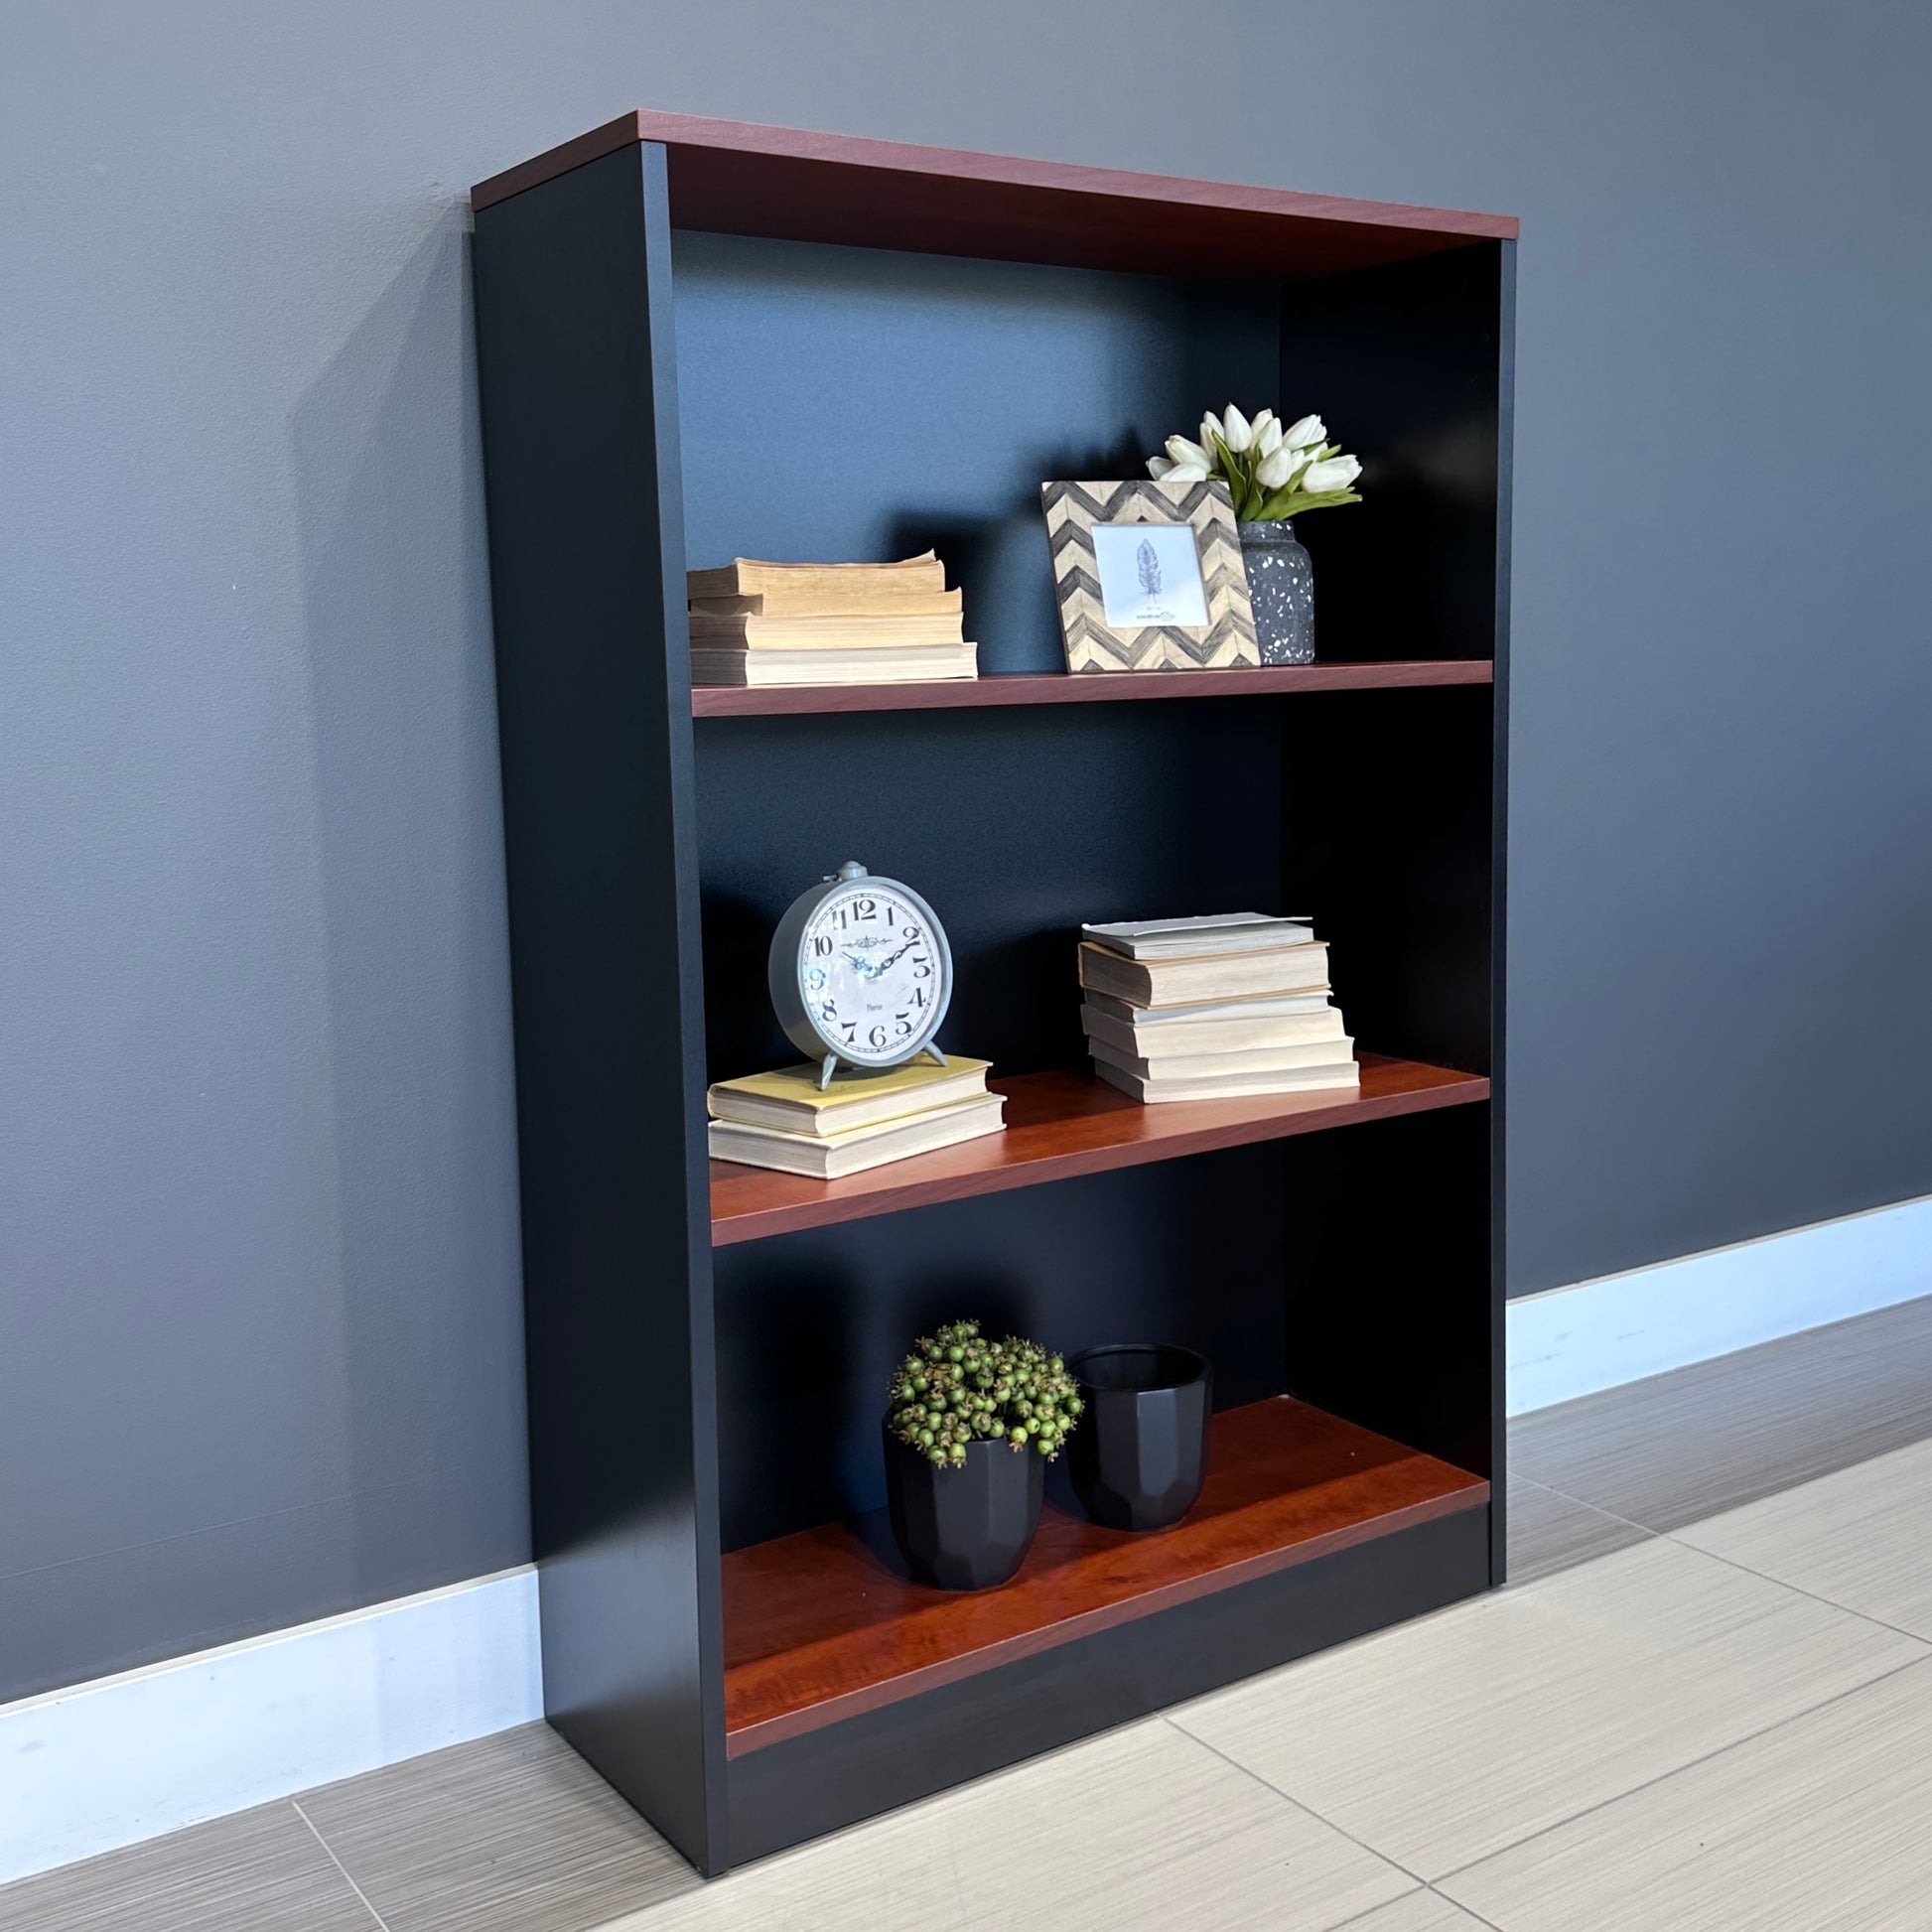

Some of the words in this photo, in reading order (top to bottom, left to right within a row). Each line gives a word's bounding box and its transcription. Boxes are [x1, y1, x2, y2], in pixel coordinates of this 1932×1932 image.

[832, 909, 847, 930] 11
[853, 899, 877, 920] 12
[887, 905, 895, 926] 1
[814, 935, 833, 956] 10
[902, 925, 920, 946] 2
[809, 968, 827, 991] 9
[907, 987, 926, 1008] 4
[822, 999, 838, 1022] 8
[840, 1021, 858, 1043] 7
[895, 1012, 912, 1035] 5
[868, 1025, 887, 1047] 6
